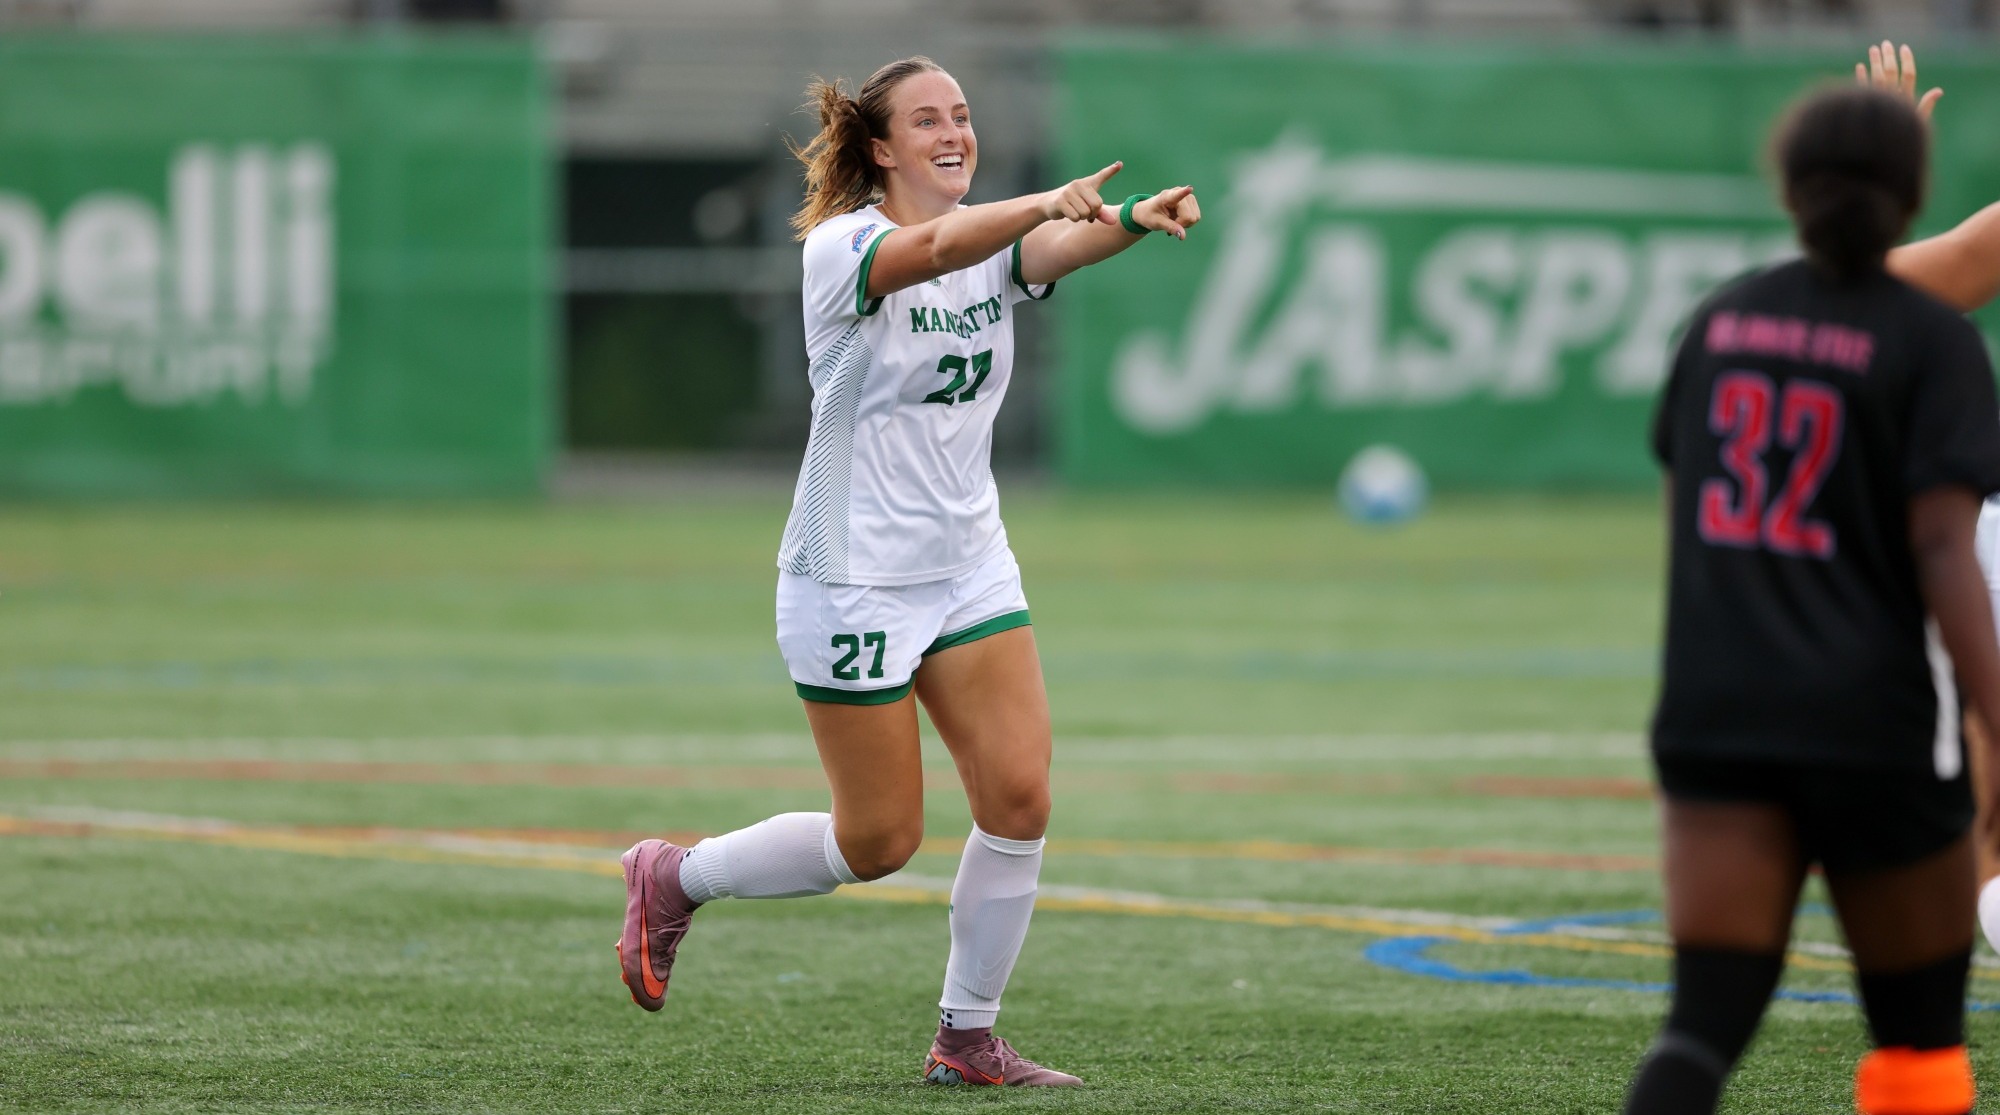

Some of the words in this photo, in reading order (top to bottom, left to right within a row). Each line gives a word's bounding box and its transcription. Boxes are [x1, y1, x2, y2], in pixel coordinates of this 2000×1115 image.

[1112, 126, 1802, 434] JASPE
[920, 347, 993, 406] 27
[1697, 372, 1843, 559] 32
[831, 630, 887, 681] 27
